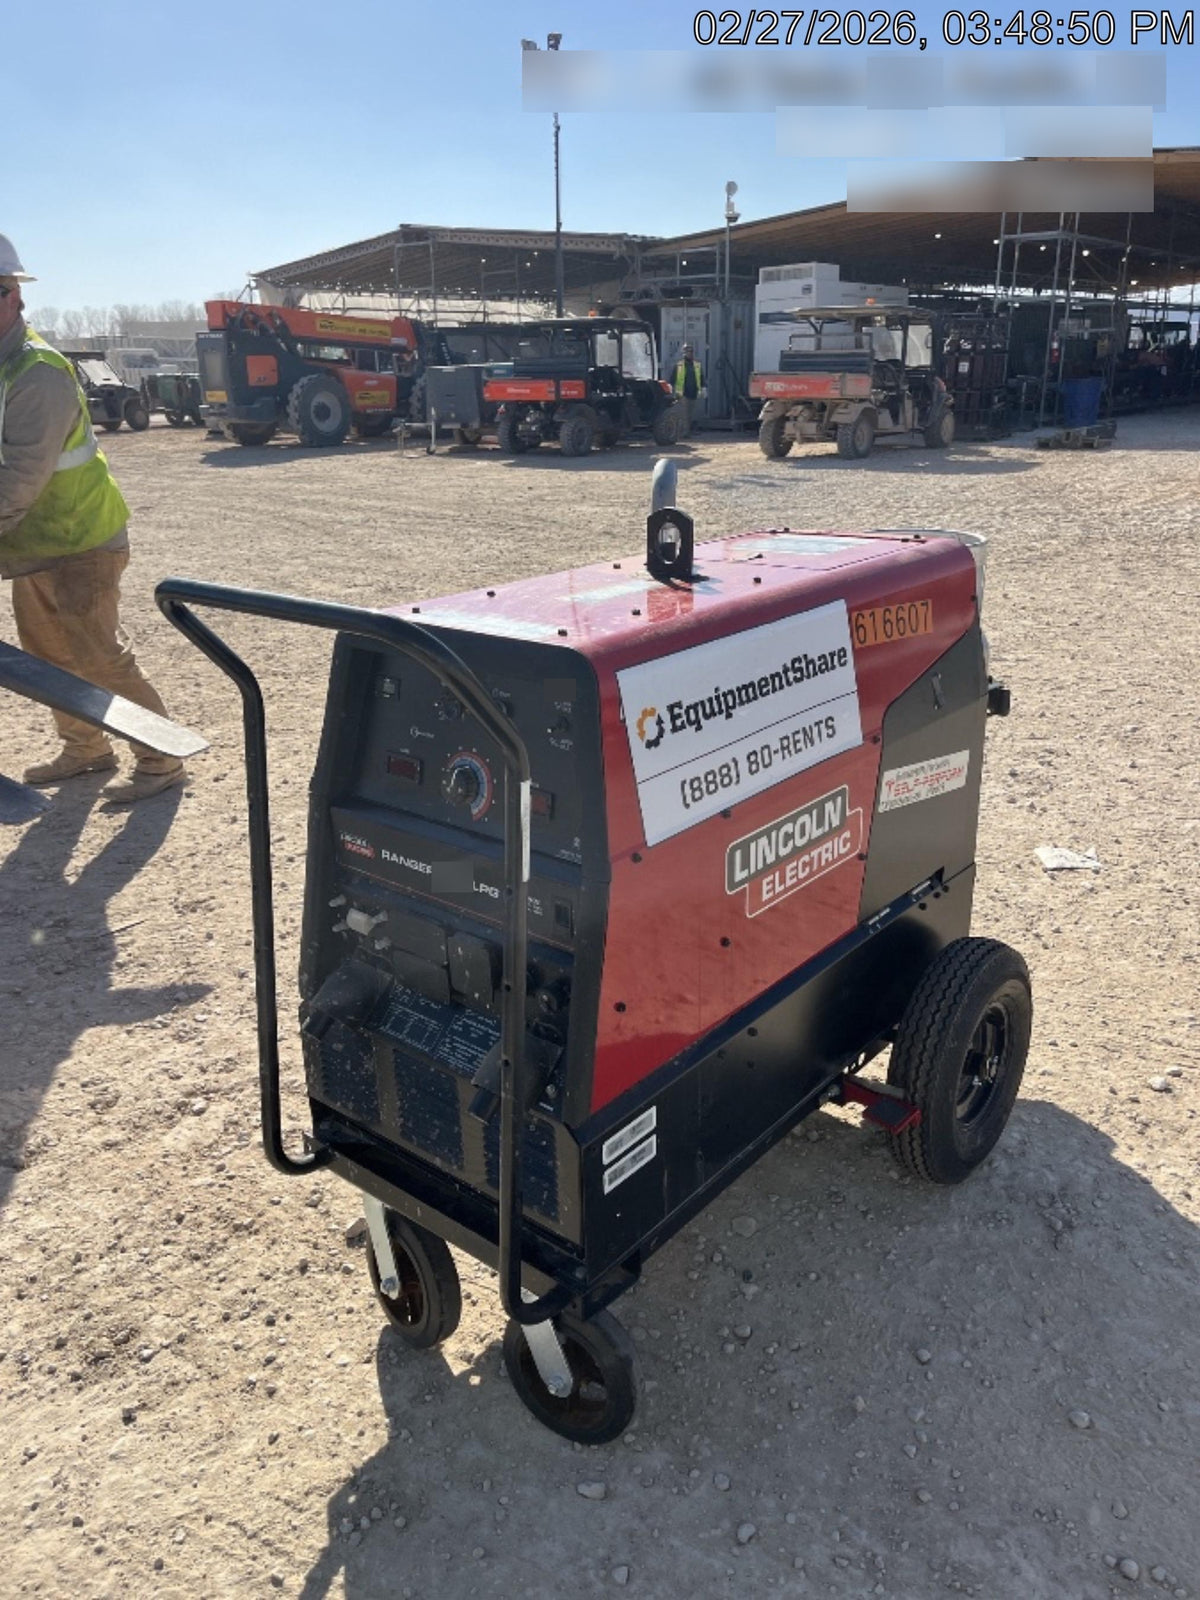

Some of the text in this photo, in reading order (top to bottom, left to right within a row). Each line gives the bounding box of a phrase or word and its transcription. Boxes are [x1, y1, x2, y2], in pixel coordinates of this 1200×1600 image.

[854, 600, 929, 645] 616607
[666, 646, 848, 734] EquipmentShare
[680, 756, 740, 809] (888)
[746, 715, 836, 776] 80-RENTS
[734, 796, 842, 883] LINCOLN
[762, 830, 851, 902] ELECTRIC
